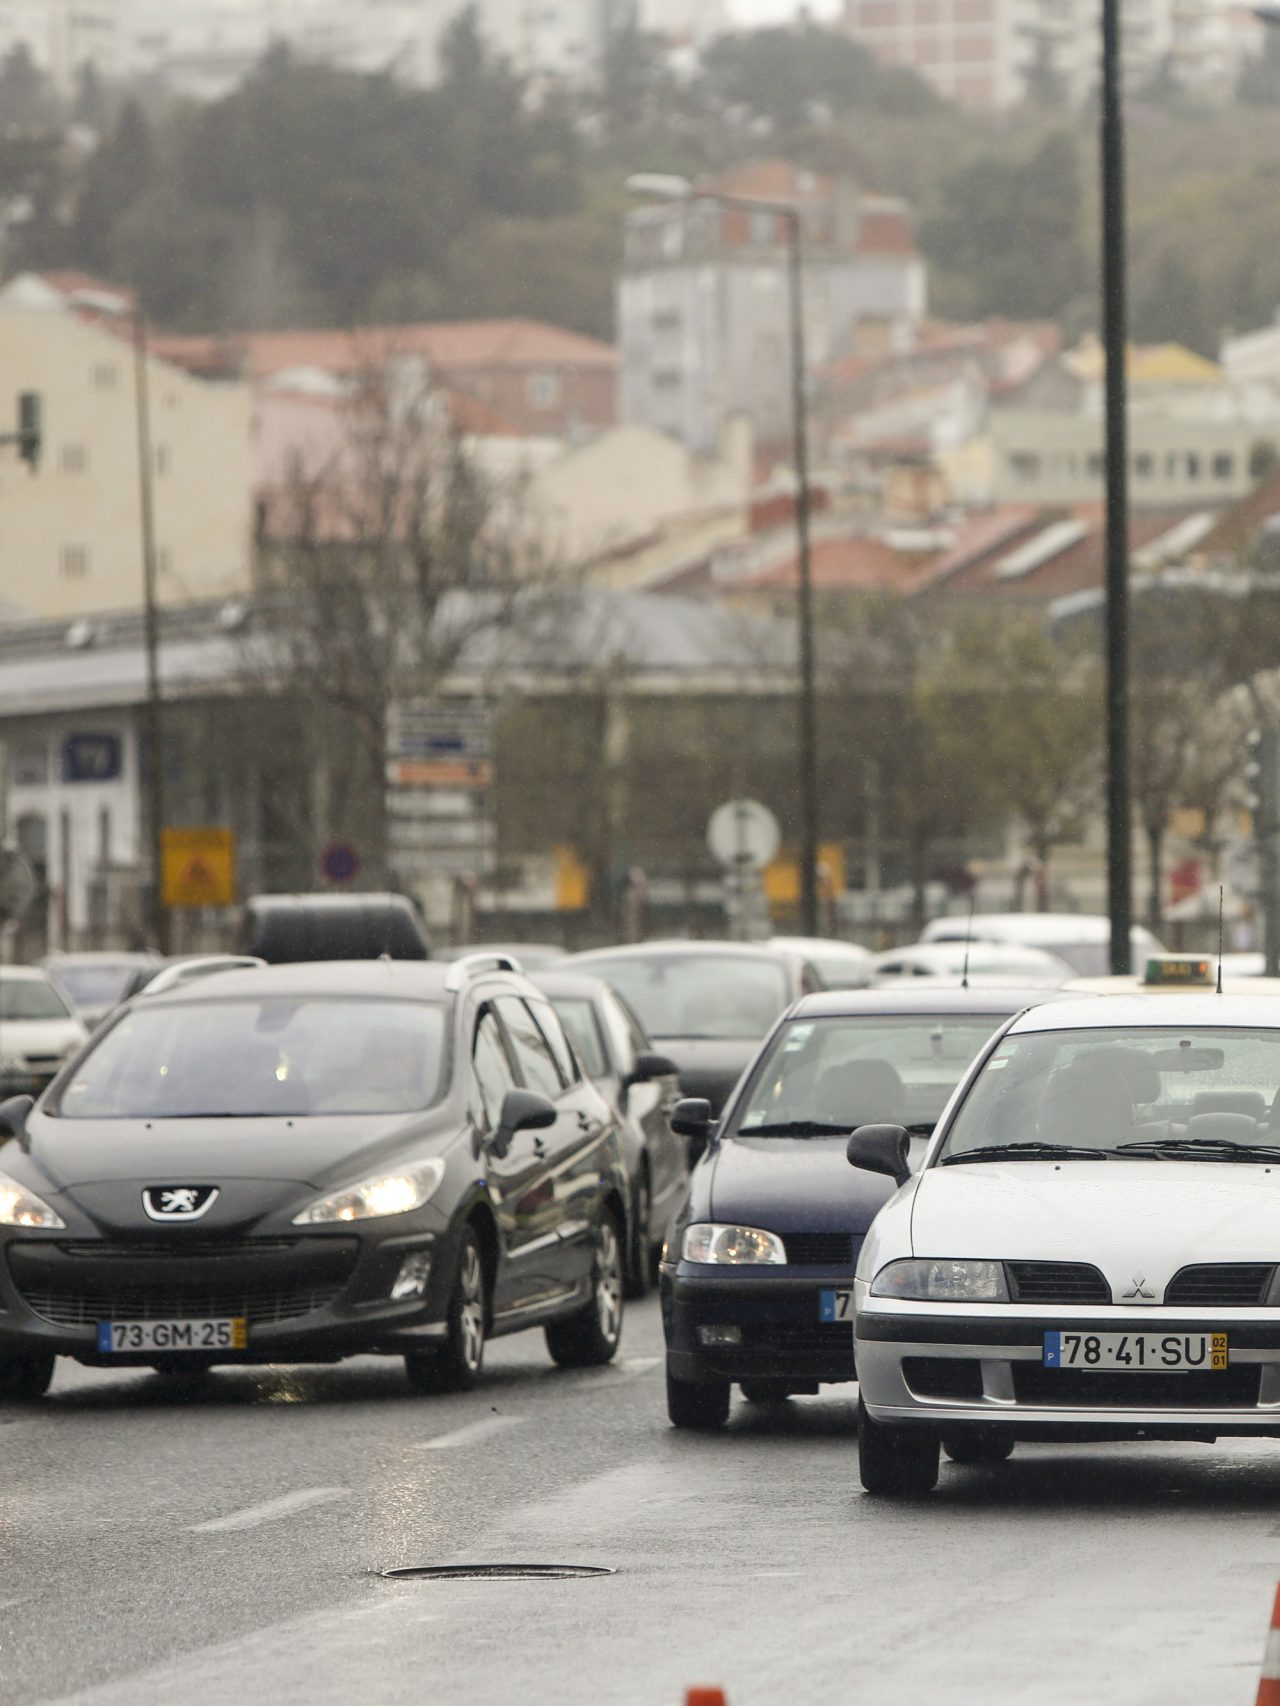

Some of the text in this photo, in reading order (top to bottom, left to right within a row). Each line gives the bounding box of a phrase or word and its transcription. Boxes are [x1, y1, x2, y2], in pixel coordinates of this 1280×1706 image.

[1212, 1337, 1225, 1348] 02
[1047, 1352, 1055, 1361] P
[1212, 1355, 1225, 1366] 01
